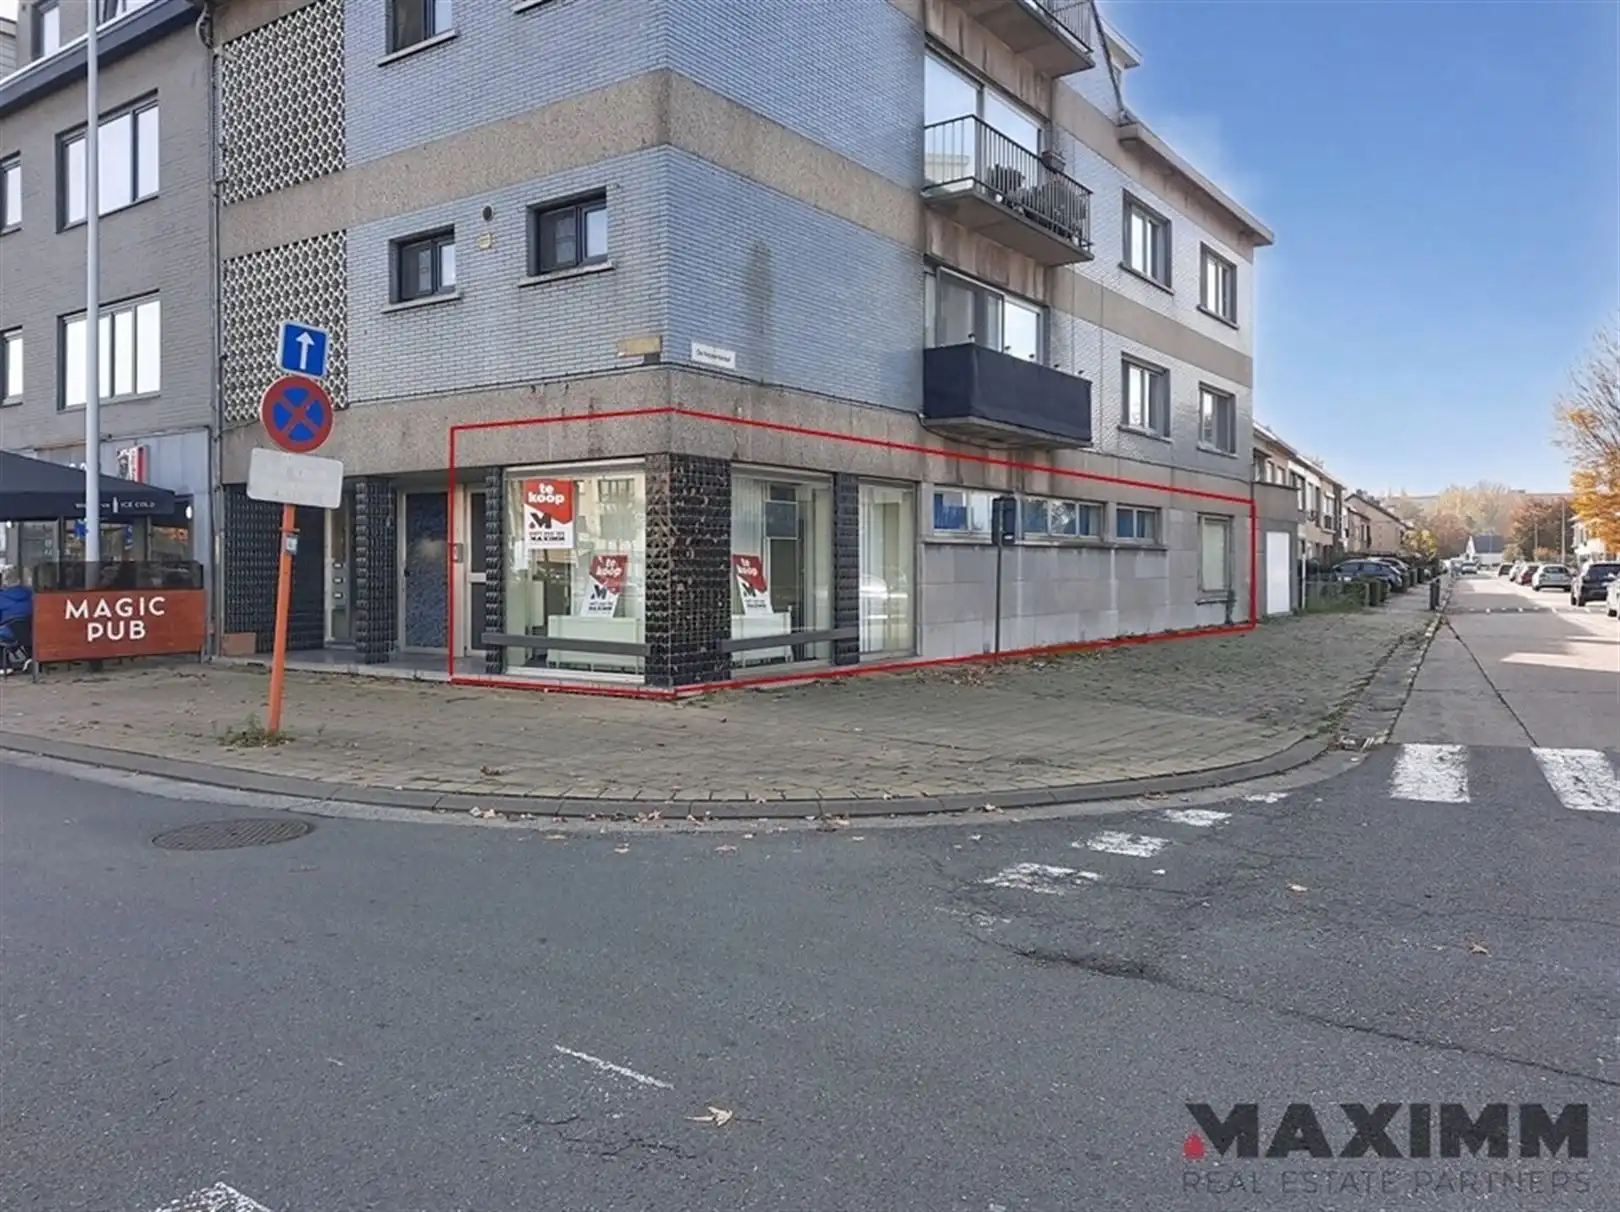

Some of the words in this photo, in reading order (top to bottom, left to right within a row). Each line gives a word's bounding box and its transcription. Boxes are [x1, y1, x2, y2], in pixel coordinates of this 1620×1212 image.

[539, 483, 554, 494] te
[528, 491, 565, 506] koop
[596, 565, 622, 578] koop
[736, 564, 758, 577] koop
[65, 596, 166, 620] MAGIC
[87, 619, 146, 642] PUB
